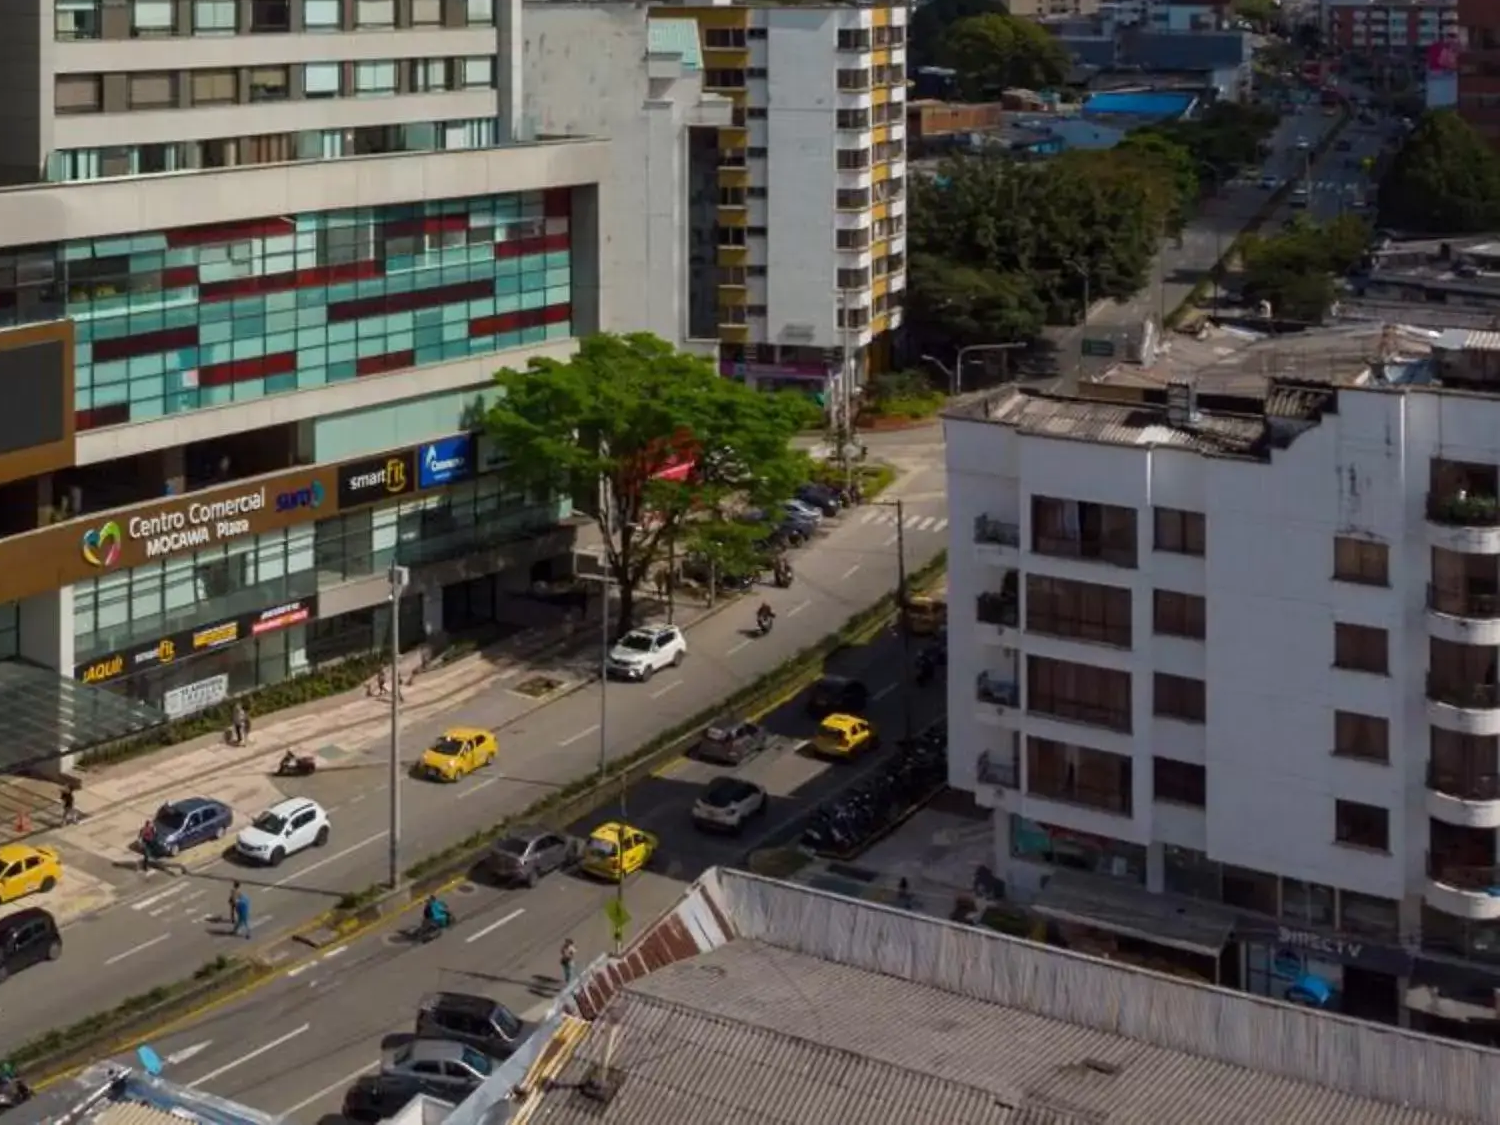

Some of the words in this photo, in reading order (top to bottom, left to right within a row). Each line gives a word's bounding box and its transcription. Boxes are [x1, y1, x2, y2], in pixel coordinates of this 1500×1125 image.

[129, 510, 185, 539] Centro
[189, 487, 265, 525] Comercial
[147, 528, 210, 558] MOCAWA
